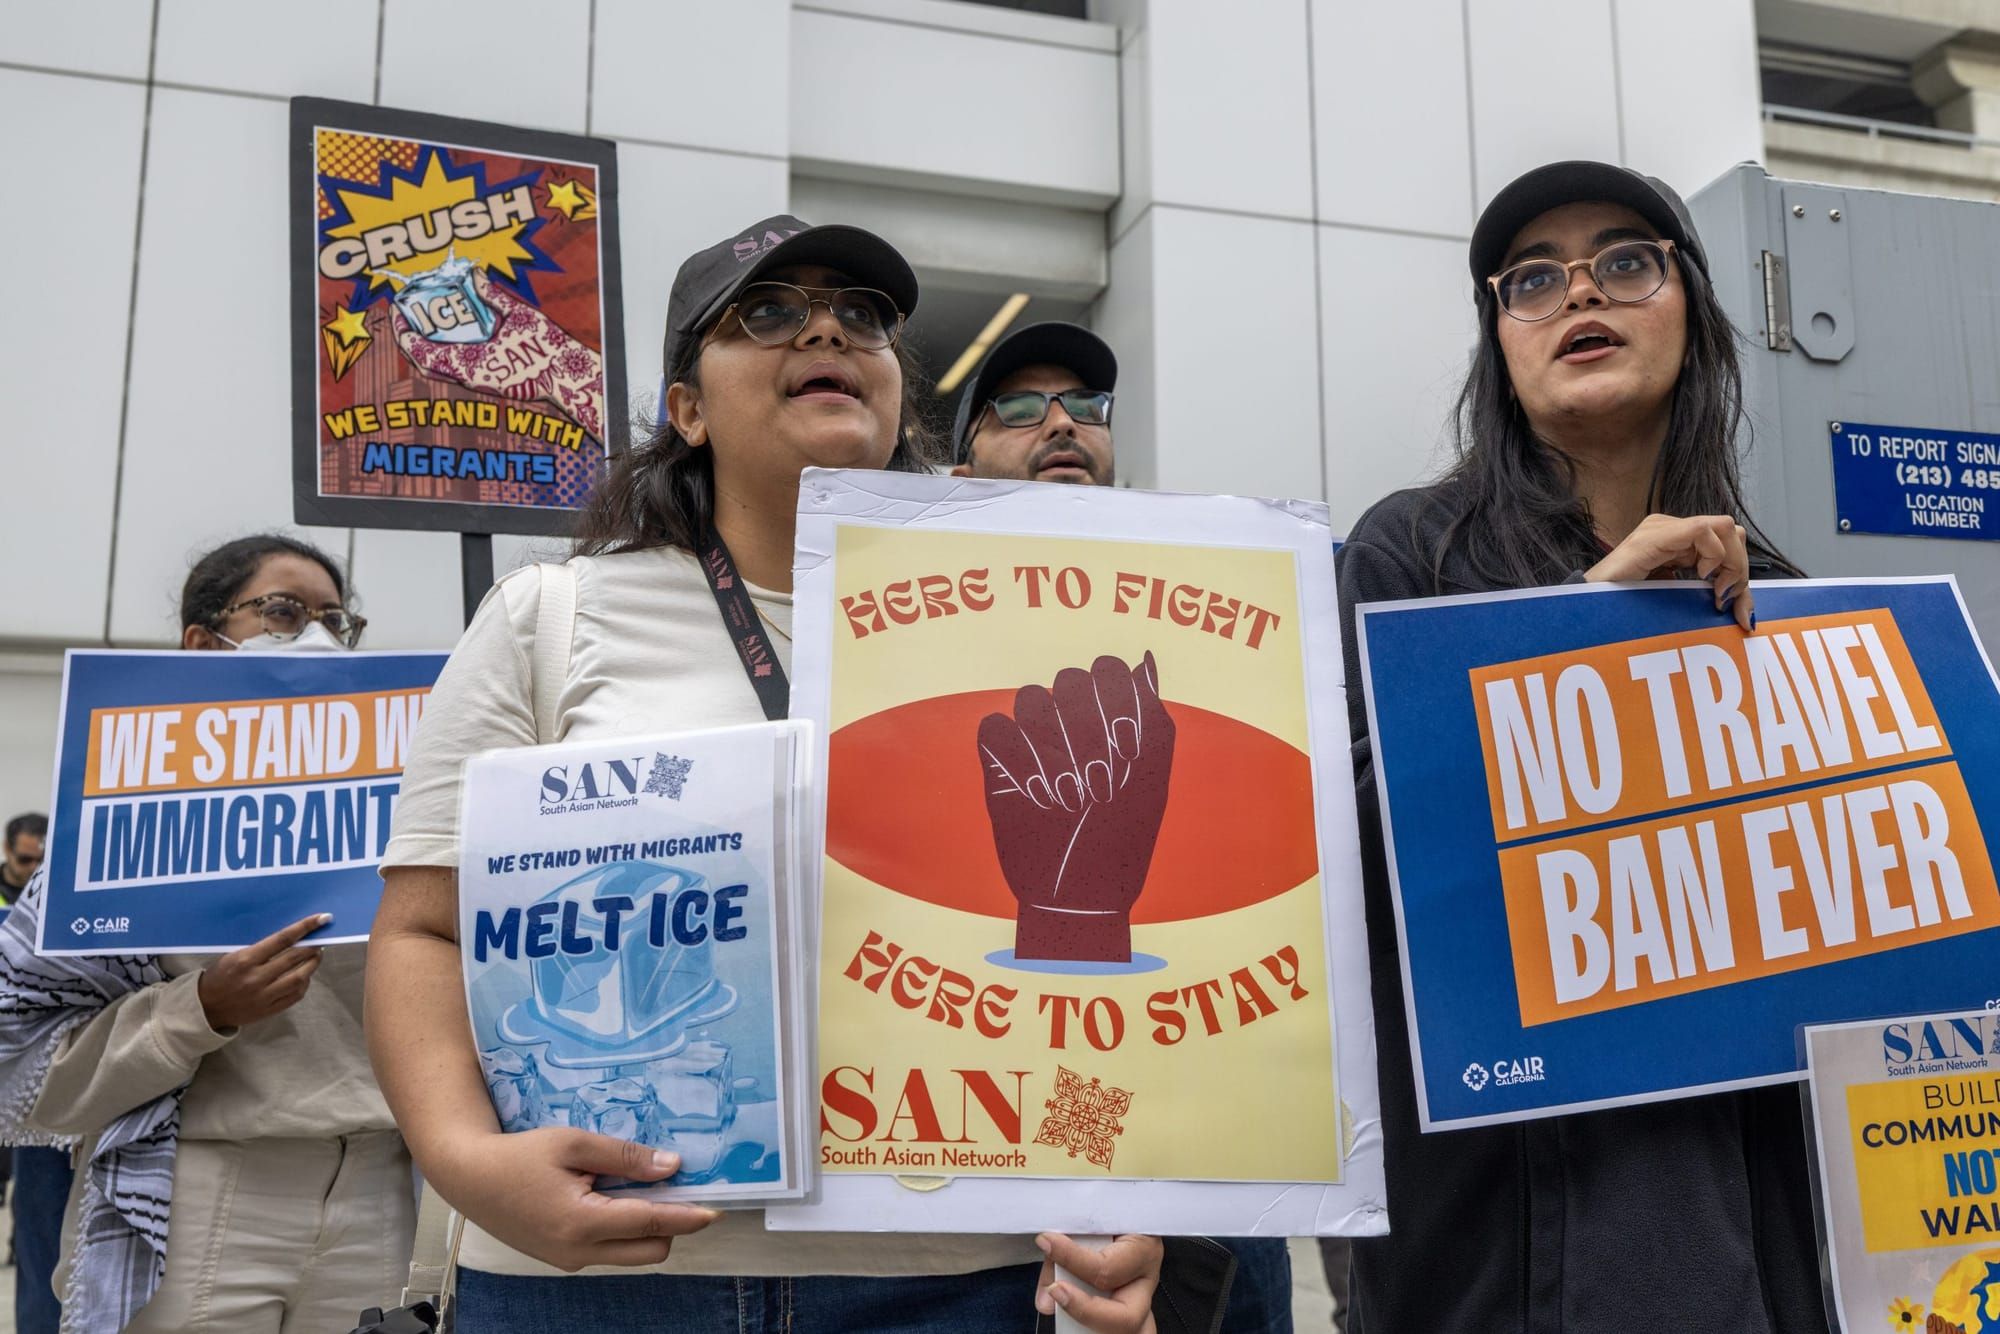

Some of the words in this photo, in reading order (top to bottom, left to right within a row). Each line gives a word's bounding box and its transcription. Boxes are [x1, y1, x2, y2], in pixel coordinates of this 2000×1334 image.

[319, 185, 537, 279] CRUSH
[410, 291, 477, 336] ICE
[487, 336, 548, 382] SAN
[324, 405, 380, 439] WE
[386, 398, 499, 430] STAND
[506, 406, 585, 450] WITH
[362, 443, 557, 484] MIGRANTS
[1848, 434, 1871, 456] TO
[1879, 436, 1948, 462] REPORT
[1957, 441, 2000, 465] SIGN
[1896, 462, 1952, 488] (213)
[1961, 469, 2000, 489] 485
[1906, 493, 1984, 513] LOCATION
[1912, 510, 1981, 529] NUMBER
[840, 568, 995, 639] HERE
[1013, 566, 1091, 609] TO
[1112, 571, 1281, 650] FIGHT
[99, 711, 182, 790] WE
[192, 700, 361, 783] STAND
[375, 693, 431, 769] W
[1484, 663, 1623, 830] NO
[1628, 623, 1942, 799] TRAVEL
[540, 757, 645, 804] SAN
[540, 803, 566, 815] South
[569, 801, 594, 813] Asian
[596, 796, 638, 809] Network
[488, 855, 515, 874] WE
[519, 849, 581, 871] STAND
[586, 843, 636, 865] WITH
[640, 832, 742, 859] MIGRANTS
[1536, 819, 1736, 1005] BAN
[1741, 779, 1973, 961] EVER
[93, 917, 129, 929] CAIR
[474, 896, 635, 963] MELT
[649, 884, 748, 948] ICE
[842, 930, 1018, 1039] HERE
[1038, 993, 1125, 1051] TO
[1146, 945, 1309, 1046] STAY
[1883, 1016, 1986, 1064] SAN
[1493, 1056, 1544, 1078] CAIR
[1495, 1074, 1545, 1086] CALIFORNIA
[1888, 1065, 1915, 1076] South
[1919, 1063, 1943, 1074] Asian
[1946, 1058, 1988, 1071] Network
[820, 1066, 1033, 1144] SAN
[821, 1146, 876, 1165] South
[882, 1146, 935, 1166] Asian
[942, 1148, 1027, 1167] Network
